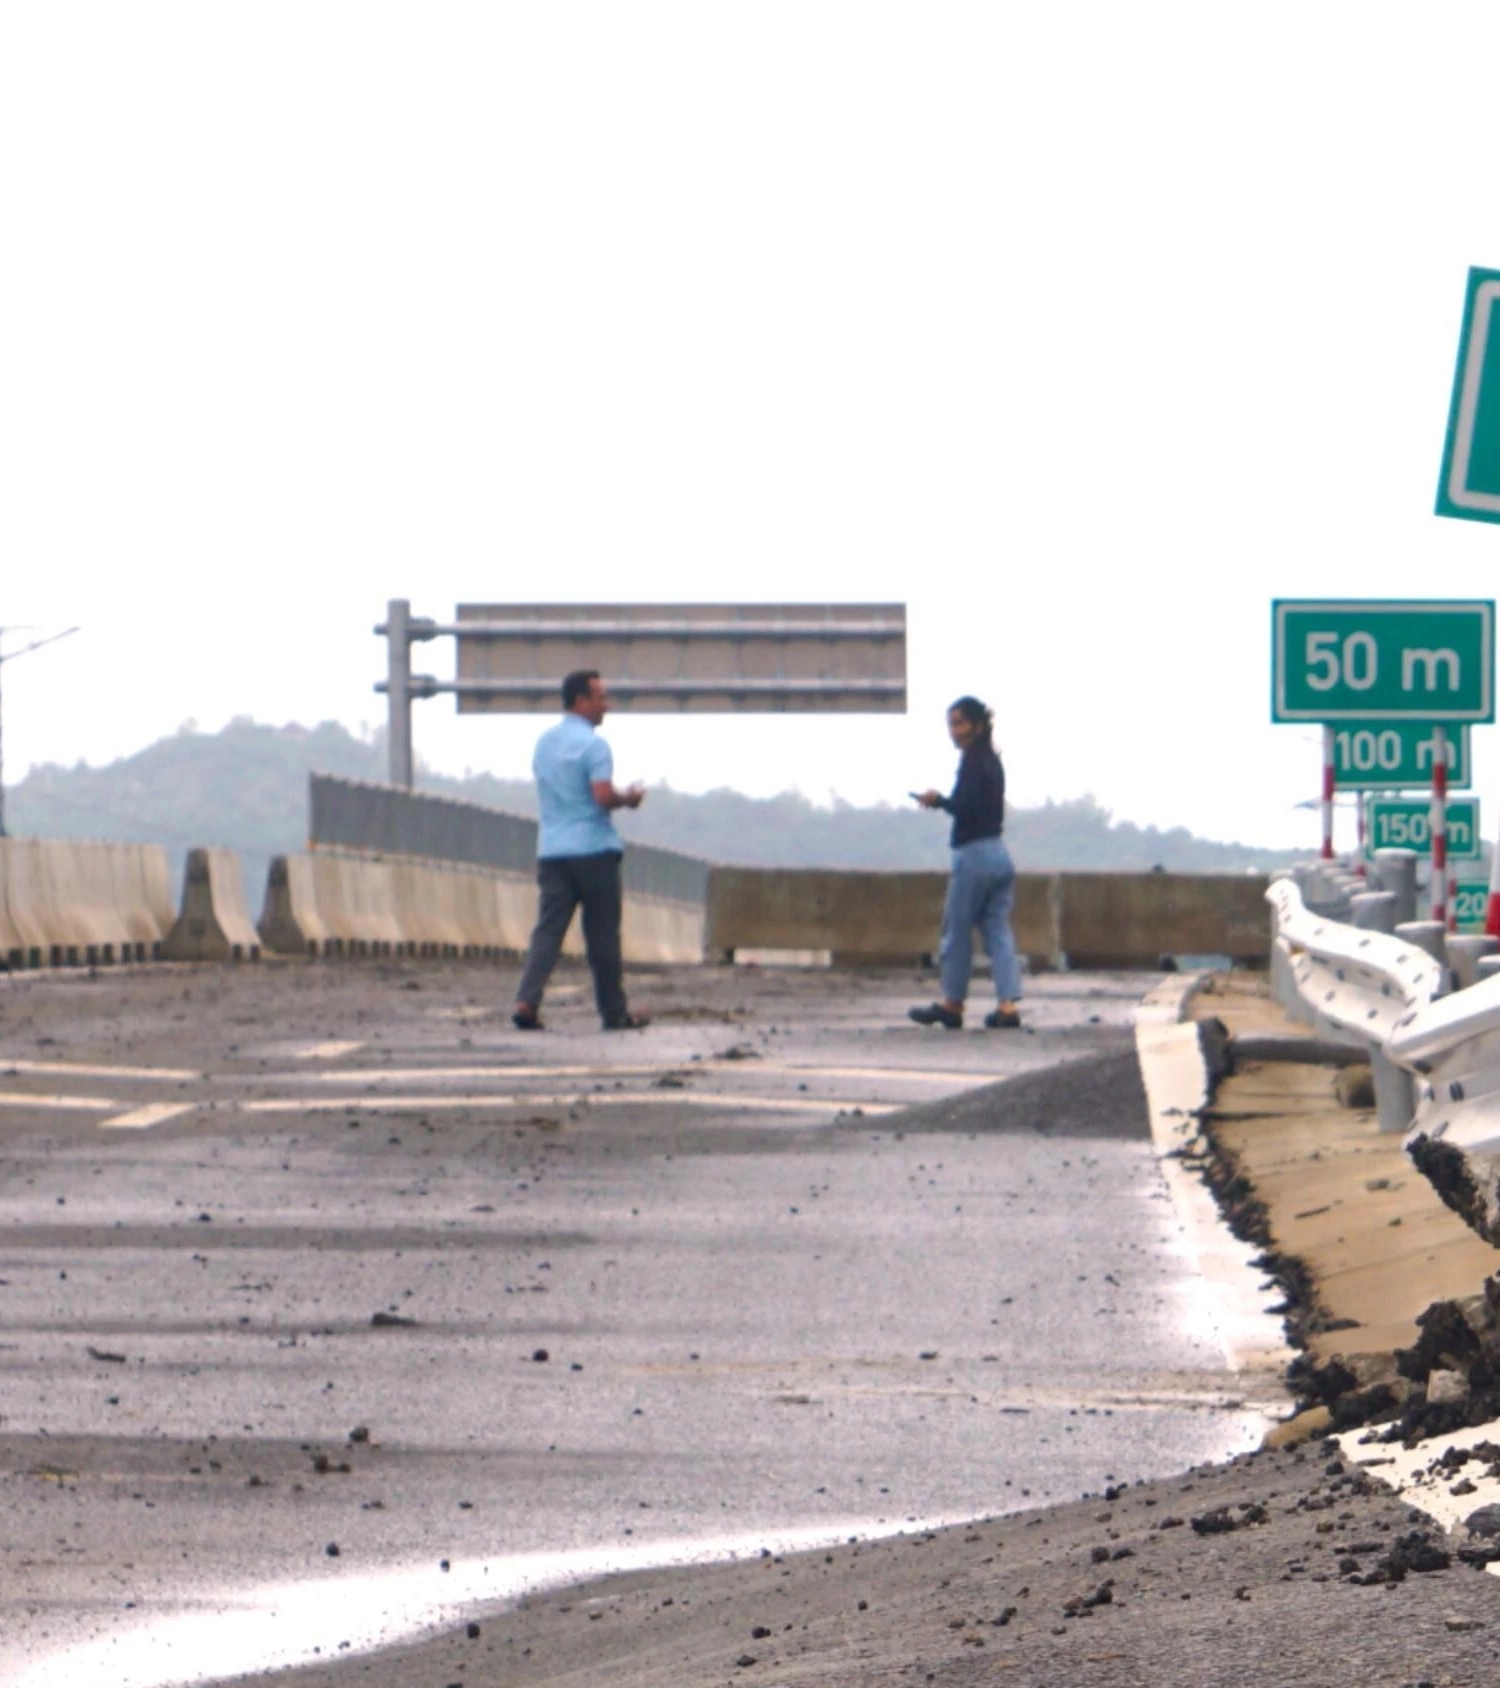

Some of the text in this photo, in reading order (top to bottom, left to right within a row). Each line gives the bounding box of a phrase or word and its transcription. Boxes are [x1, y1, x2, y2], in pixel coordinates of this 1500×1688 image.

[1305, 630, 1460, 691] 50 m
[1336, 730, 1456, 770] 100 m
[1378, 813, 1428, 844] 150
